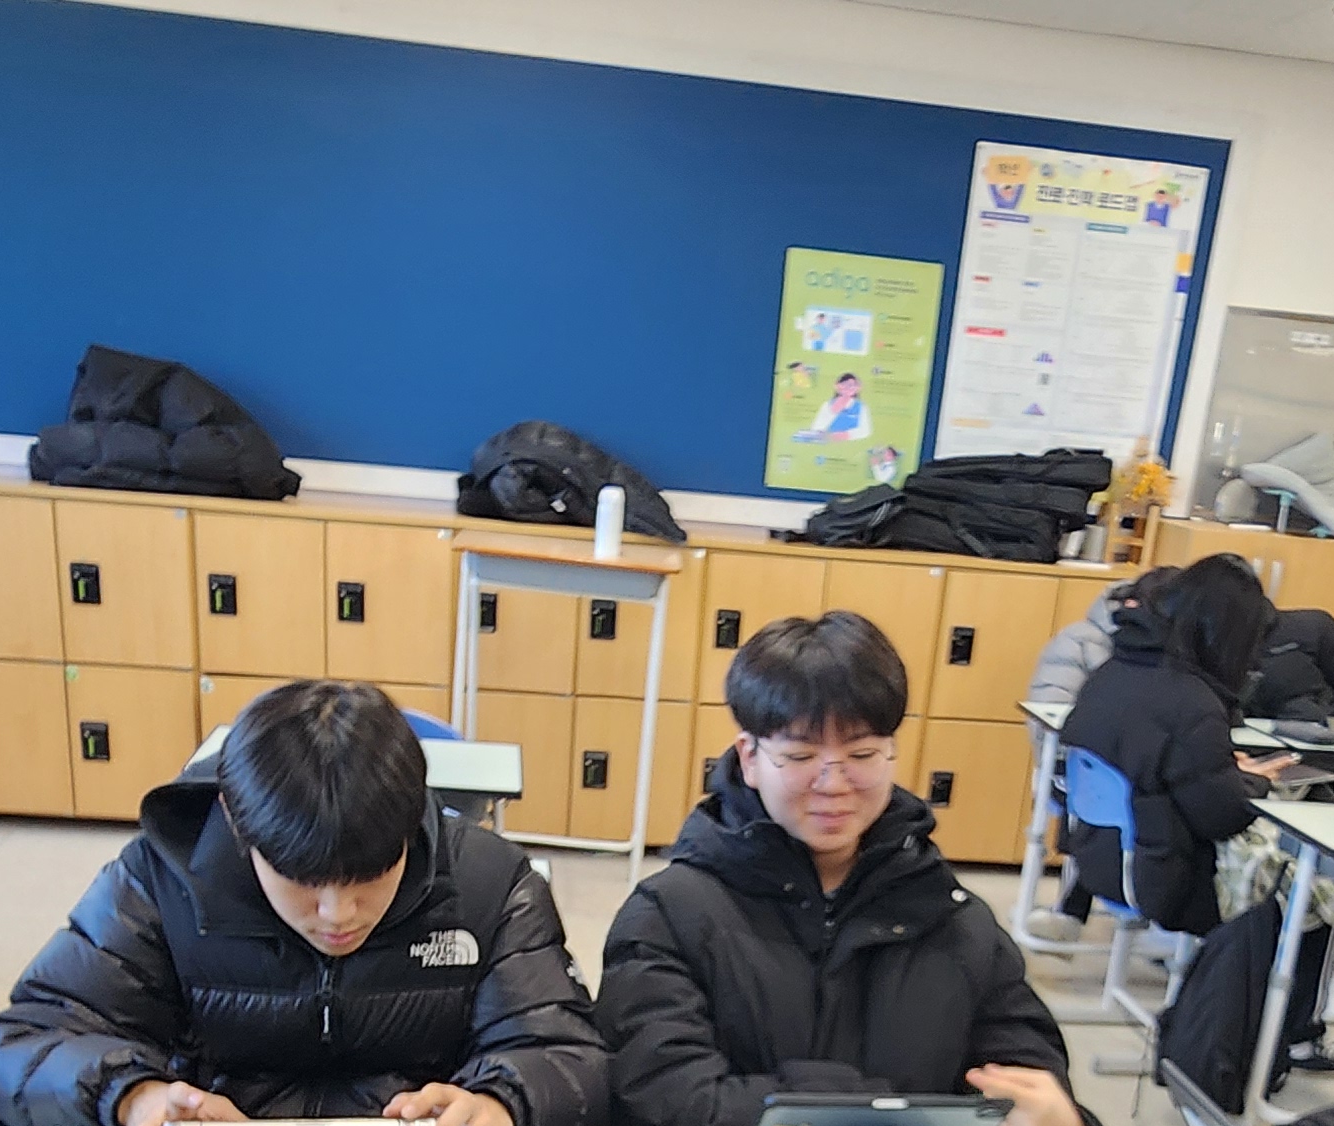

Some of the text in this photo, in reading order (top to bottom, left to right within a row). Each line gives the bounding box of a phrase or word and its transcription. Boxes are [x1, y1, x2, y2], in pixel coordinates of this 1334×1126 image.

[428, 930, 455, 943] THE
[410, 942, 455, 958] NORTH
[422, 955, 455, 968] FACE
